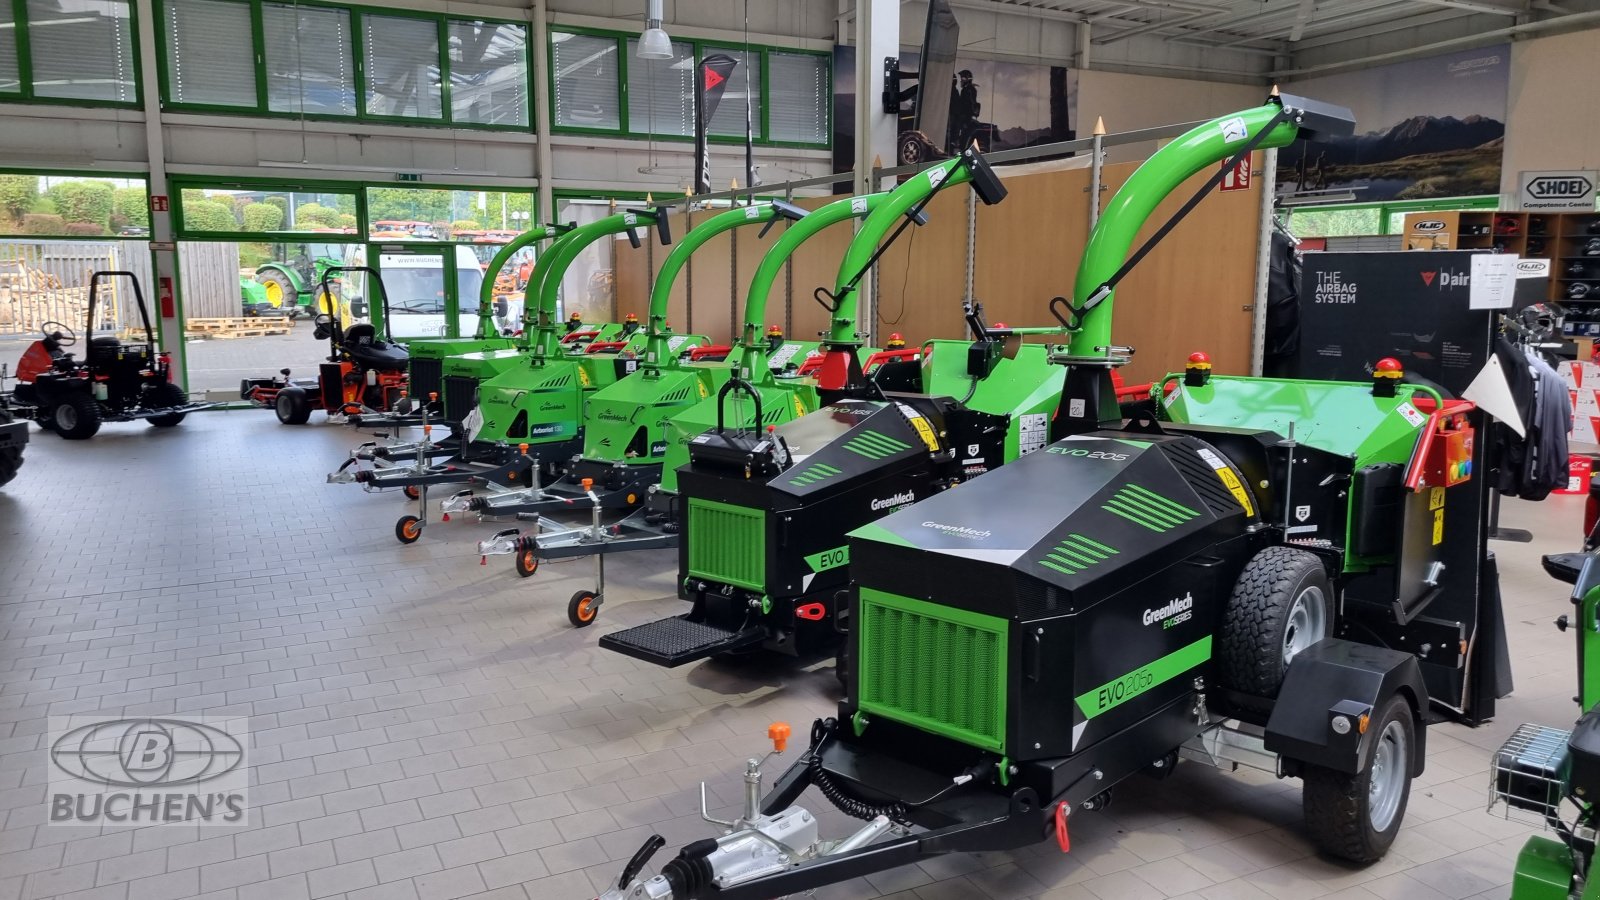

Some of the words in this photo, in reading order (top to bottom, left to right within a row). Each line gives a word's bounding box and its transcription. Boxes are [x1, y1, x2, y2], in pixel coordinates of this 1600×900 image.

[1535, 180, 1583, 195] SHOEI
[1415, 222, 1442, 230] HJC
[1315, 271, 1341, 284] THE
[1315, 283, 1357, 294] AIRBAG
[1315, 293, 1356, 304] SYSTEM
[597, 412, 628, 422] GreenMech
[1046, 447, 1089, 456] EVO
[1087, 451, 1130, 461] 205
[871, 489, 915, 511] GreenMech
[921, 521, 992, 538] GreenMech
[820, 550, 844, 569] EVO
[1142, 591, 1193, 626] GreenMech
[1163, 609, 1192, 630] EVOSERIES
[1098, 681, 1125, 710] EVO
